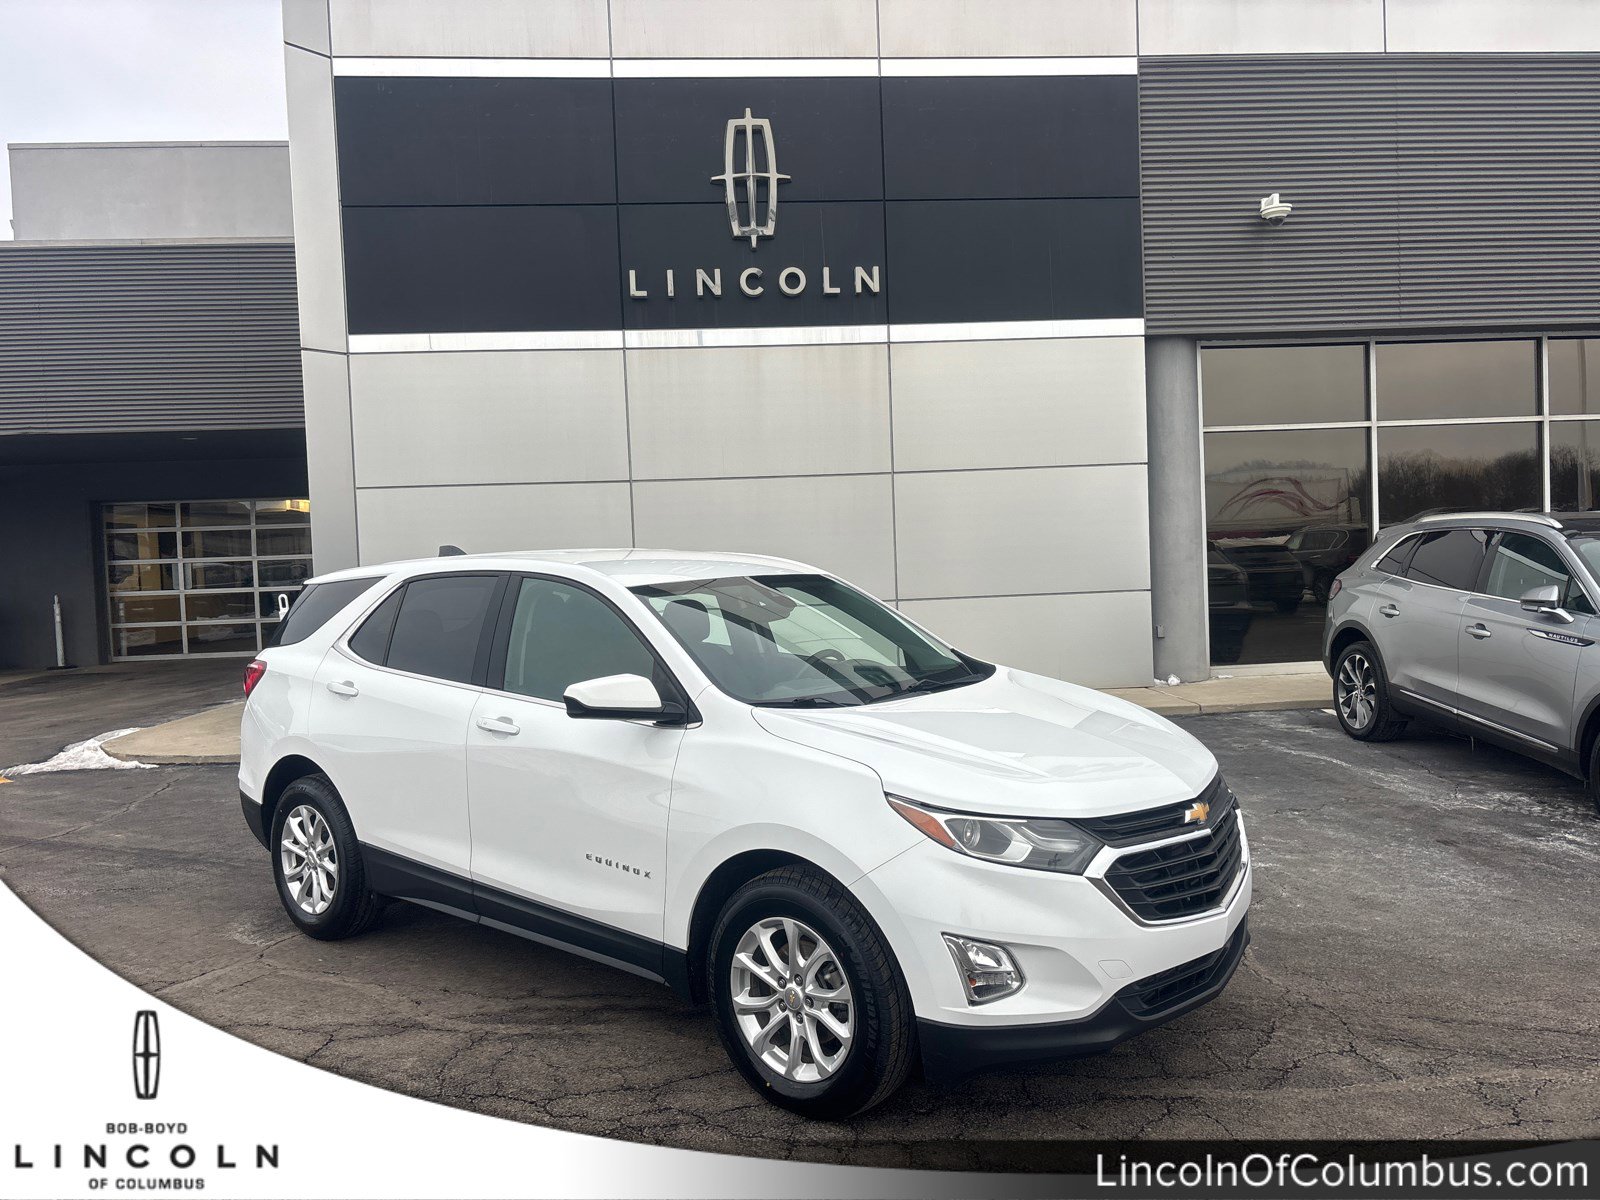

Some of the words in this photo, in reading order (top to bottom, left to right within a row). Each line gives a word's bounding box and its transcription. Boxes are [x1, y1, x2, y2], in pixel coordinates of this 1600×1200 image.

[628, 265, 881, 299] LINCOLN
[1548, 633, 1578, 643] NAUTILUS
[585, 853, 651, 879] EQUINOX
